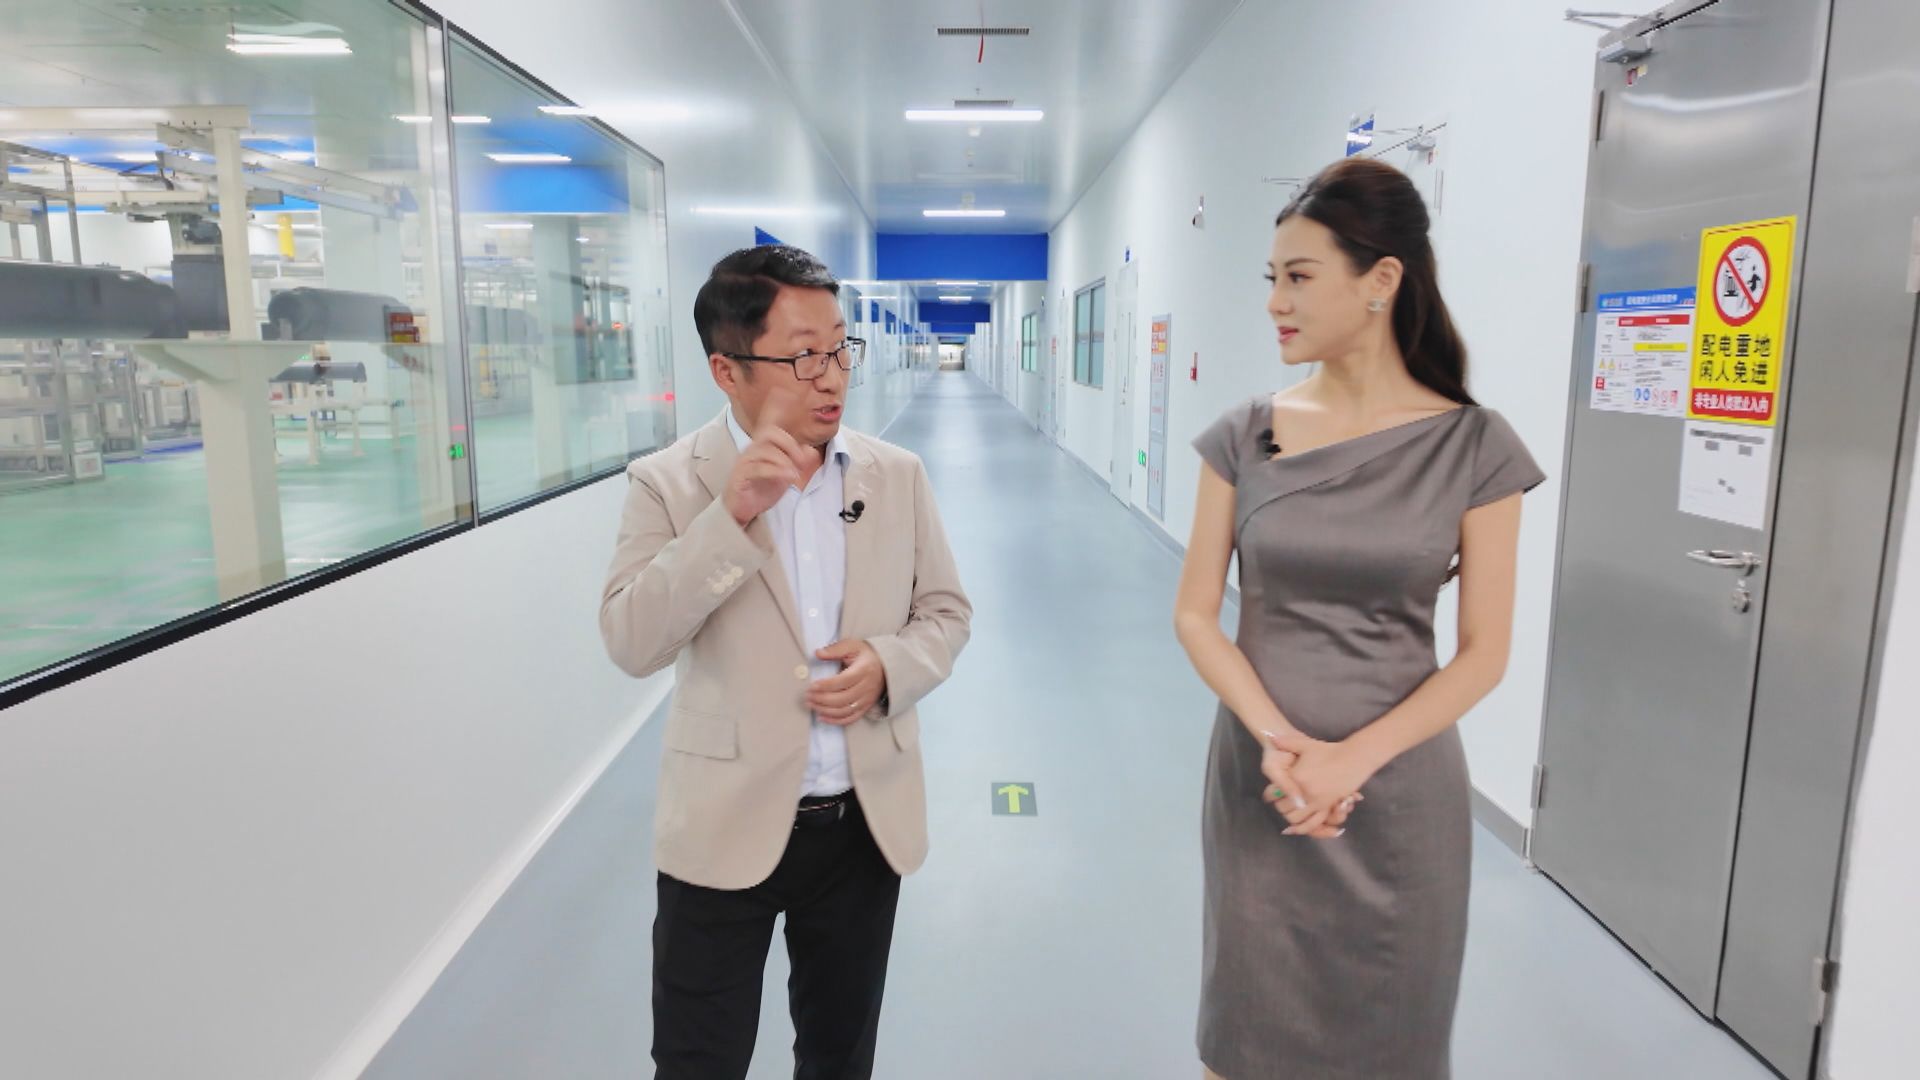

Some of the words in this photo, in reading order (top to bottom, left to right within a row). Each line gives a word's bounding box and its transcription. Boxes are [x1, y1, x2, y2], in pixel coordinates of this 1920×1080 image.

[1701, 333, 1770, 357] 配电重地
[1699, 360, 1767, 384] 闲人免进
